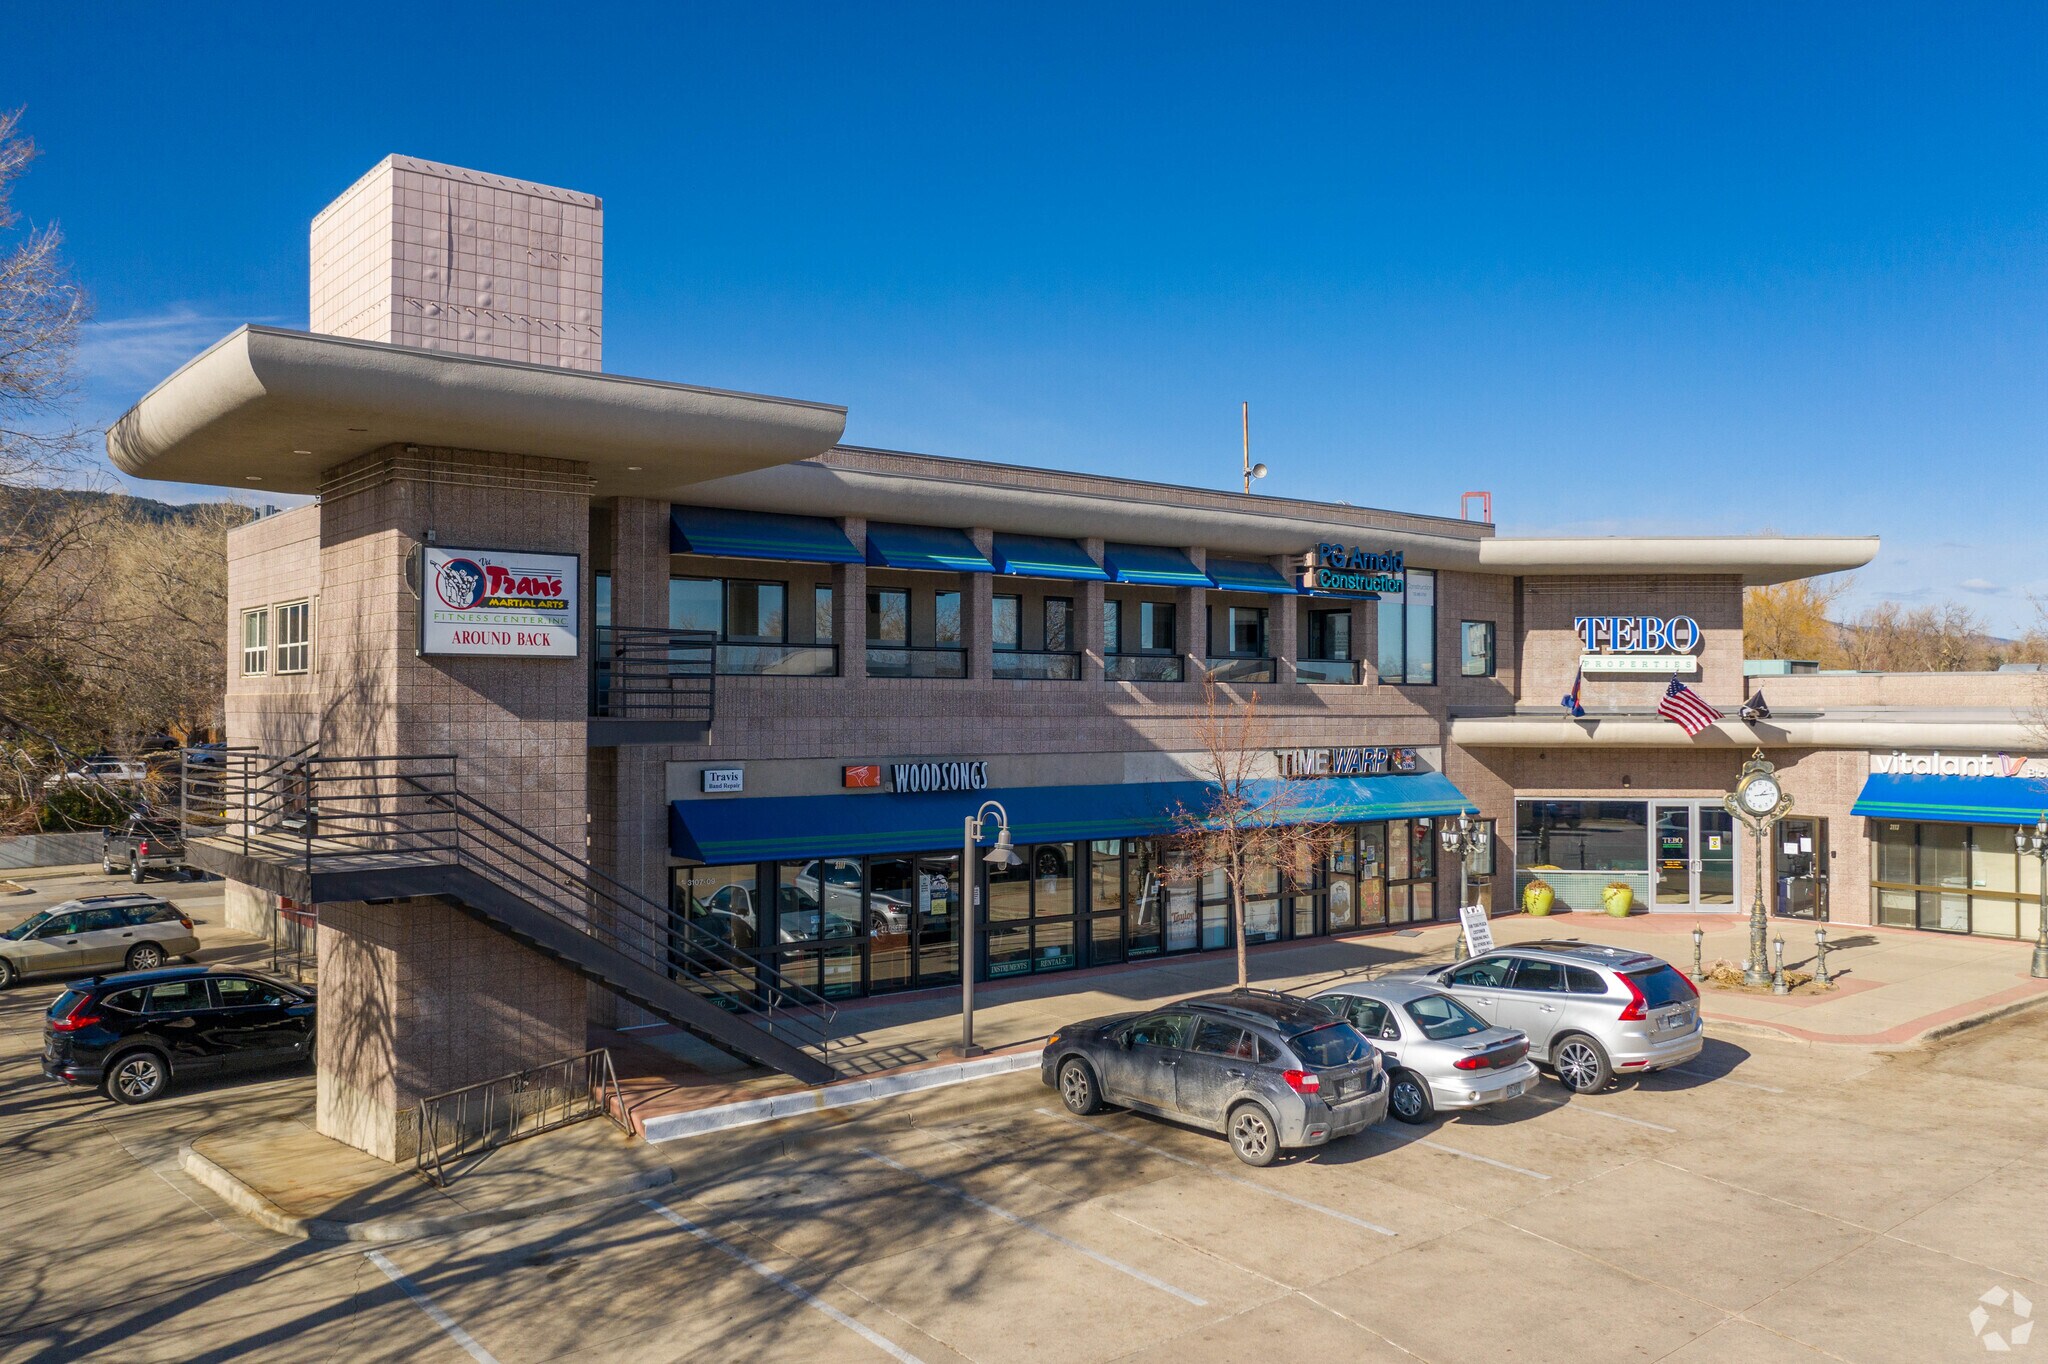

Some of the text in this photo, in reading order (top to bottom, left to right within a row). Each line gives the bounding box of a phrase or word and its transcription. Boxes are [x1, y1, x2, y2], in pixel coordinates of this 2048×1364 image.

[1318, 542, 1404, 572] PG Arnold
[486, 565, 562, 597] Tran's
[1319, 568, 1404, 592] Construction
[488, 598, 564, 609] MARTIAL ARTS
[433, 612, 489, 622] FITNESS
[452, 630, 551, 647] AROUND BACK
[1574, 615, 1700, 651] TEBO
[1584, 660, 1692, 668] PROPERTIES
[1276, 747, 1388, 775] TIME WARP
[1876, 750, 1994, 777] vitalant
[709, 772, 739, 781] Travis
[893, 761, 989, 793] WOODSONGS
[723, 782, 741, 790] Repair
[1662, 836, 1683, 844] TEBO
[1171, 909, 1195, 924] Taylor
[991, 961, 1028, 974] INSTRUMENTS
[1040, 957, 1067, 968] RENTALS
